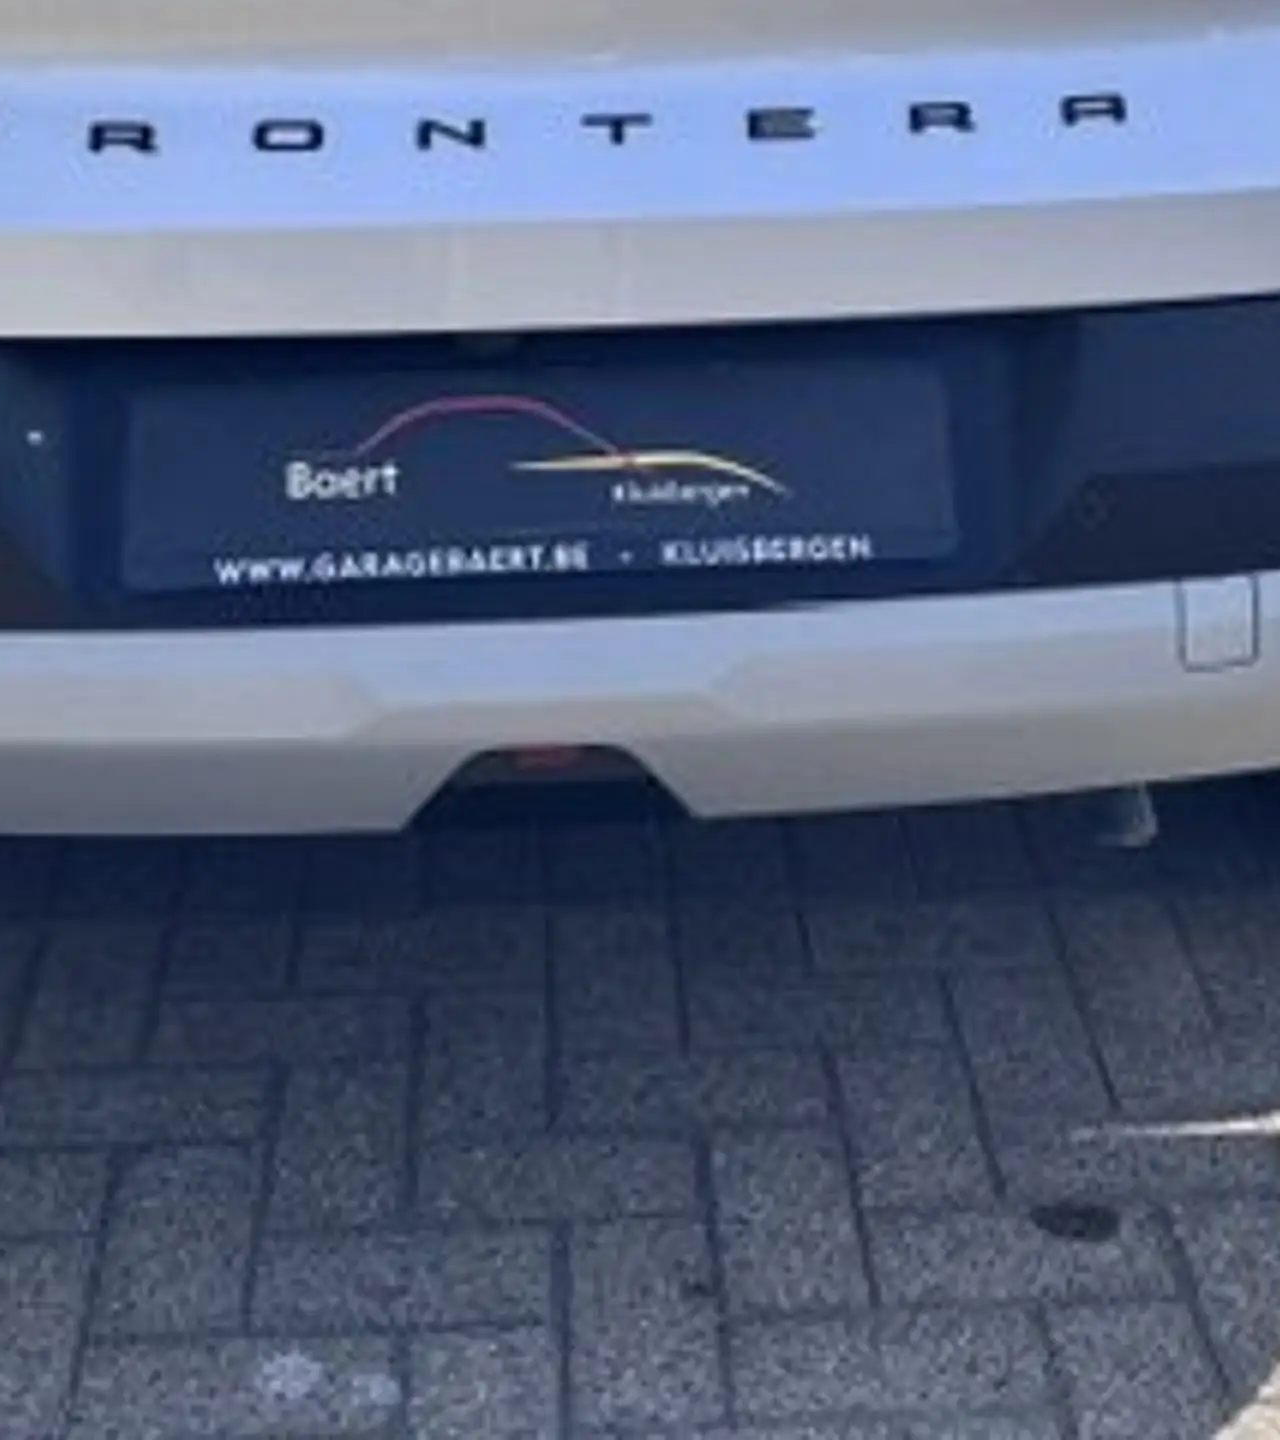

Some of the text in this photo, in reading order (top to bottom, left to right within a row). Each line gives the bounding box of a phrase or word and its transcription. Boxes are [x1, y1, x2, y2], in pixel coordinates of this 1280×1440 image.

[285, 459, 400, 501] Baert
[214, 534, 872, 585] WWW.GARAGEBAERT.BE KLUISBERGEN
